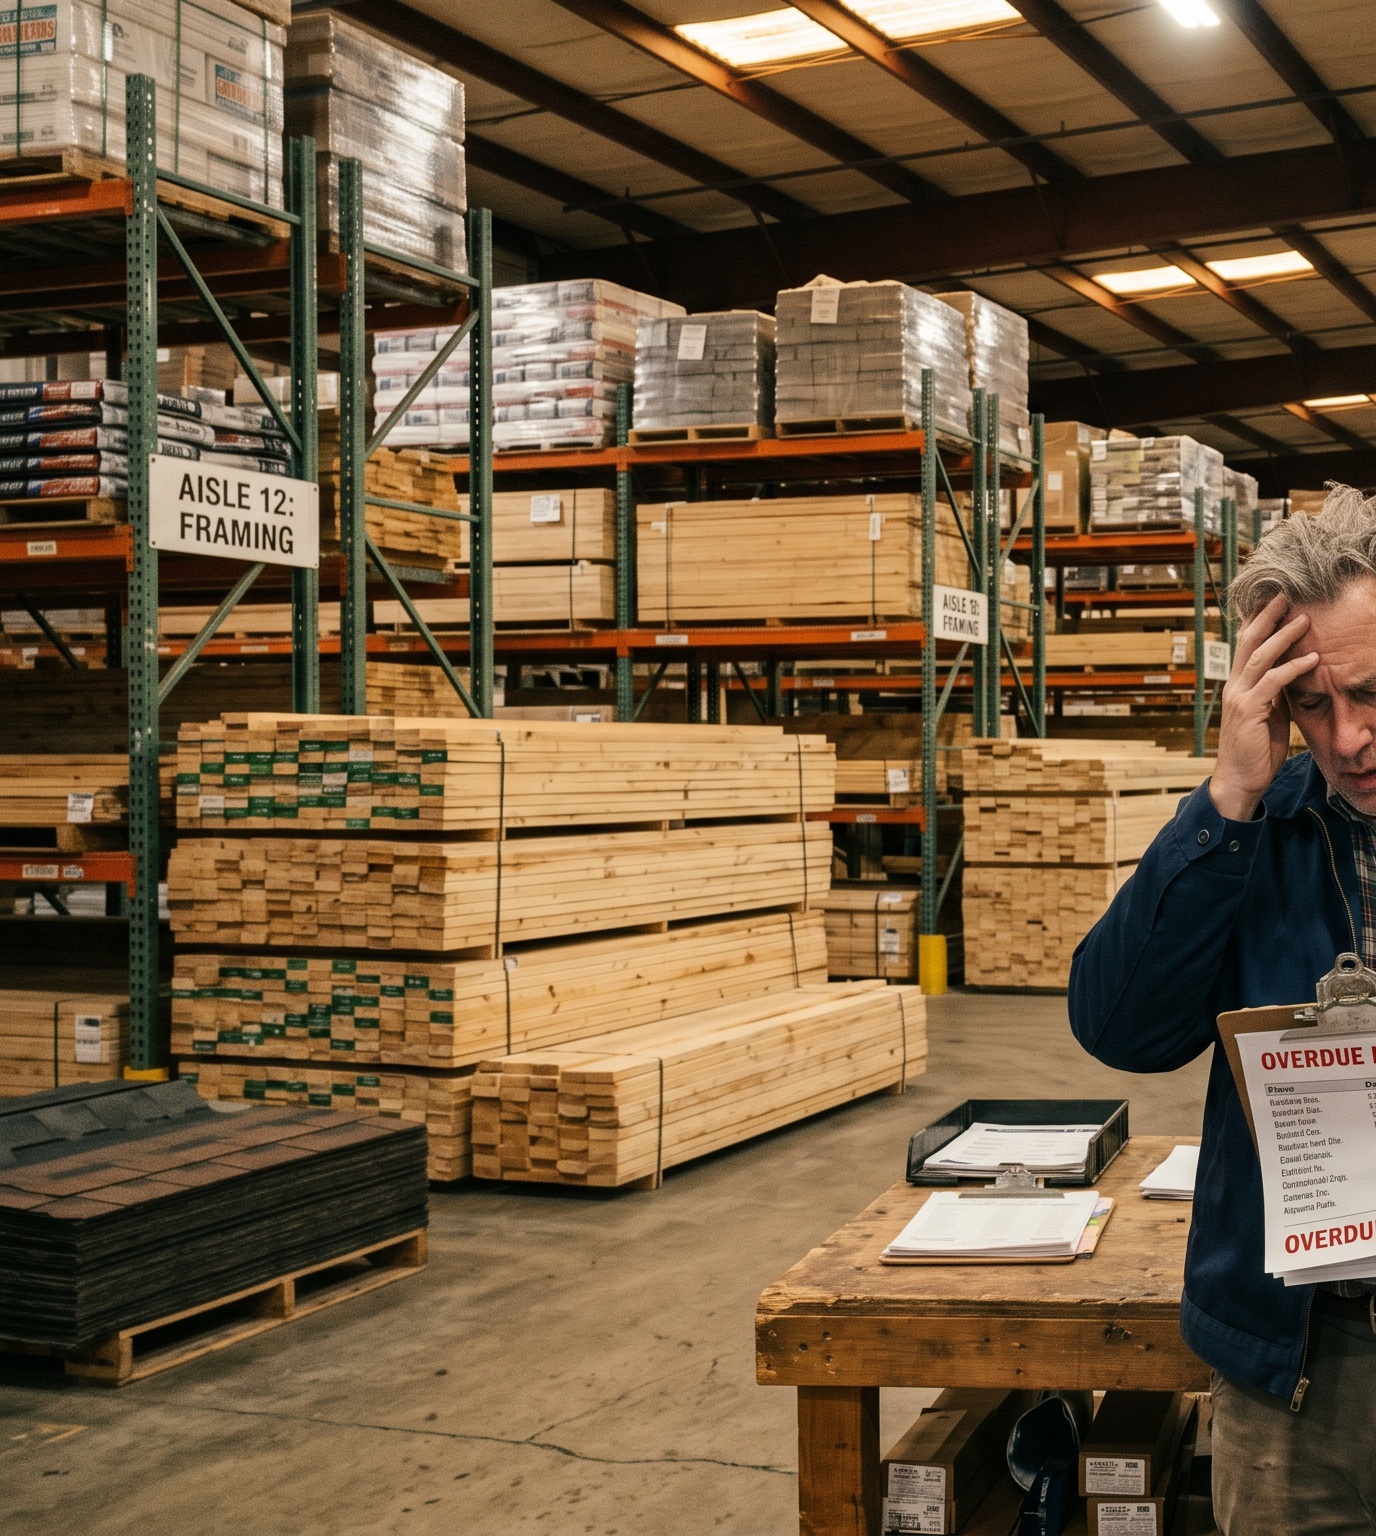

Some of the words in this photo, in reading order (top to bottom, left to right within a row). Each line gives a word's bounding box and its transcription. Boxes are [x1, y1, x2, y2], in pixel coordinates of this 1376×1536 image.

[179, 473, 251, 510] AISLE
[260, 487, 294, 516] 12:
[180, 512, 294, 555] FRAMING
[943, 593, 967, 614] AISLE
[1261, 1046, 1365, 1071] OVERDUE
[1316, 1189, 1330, 1197] Inc.
